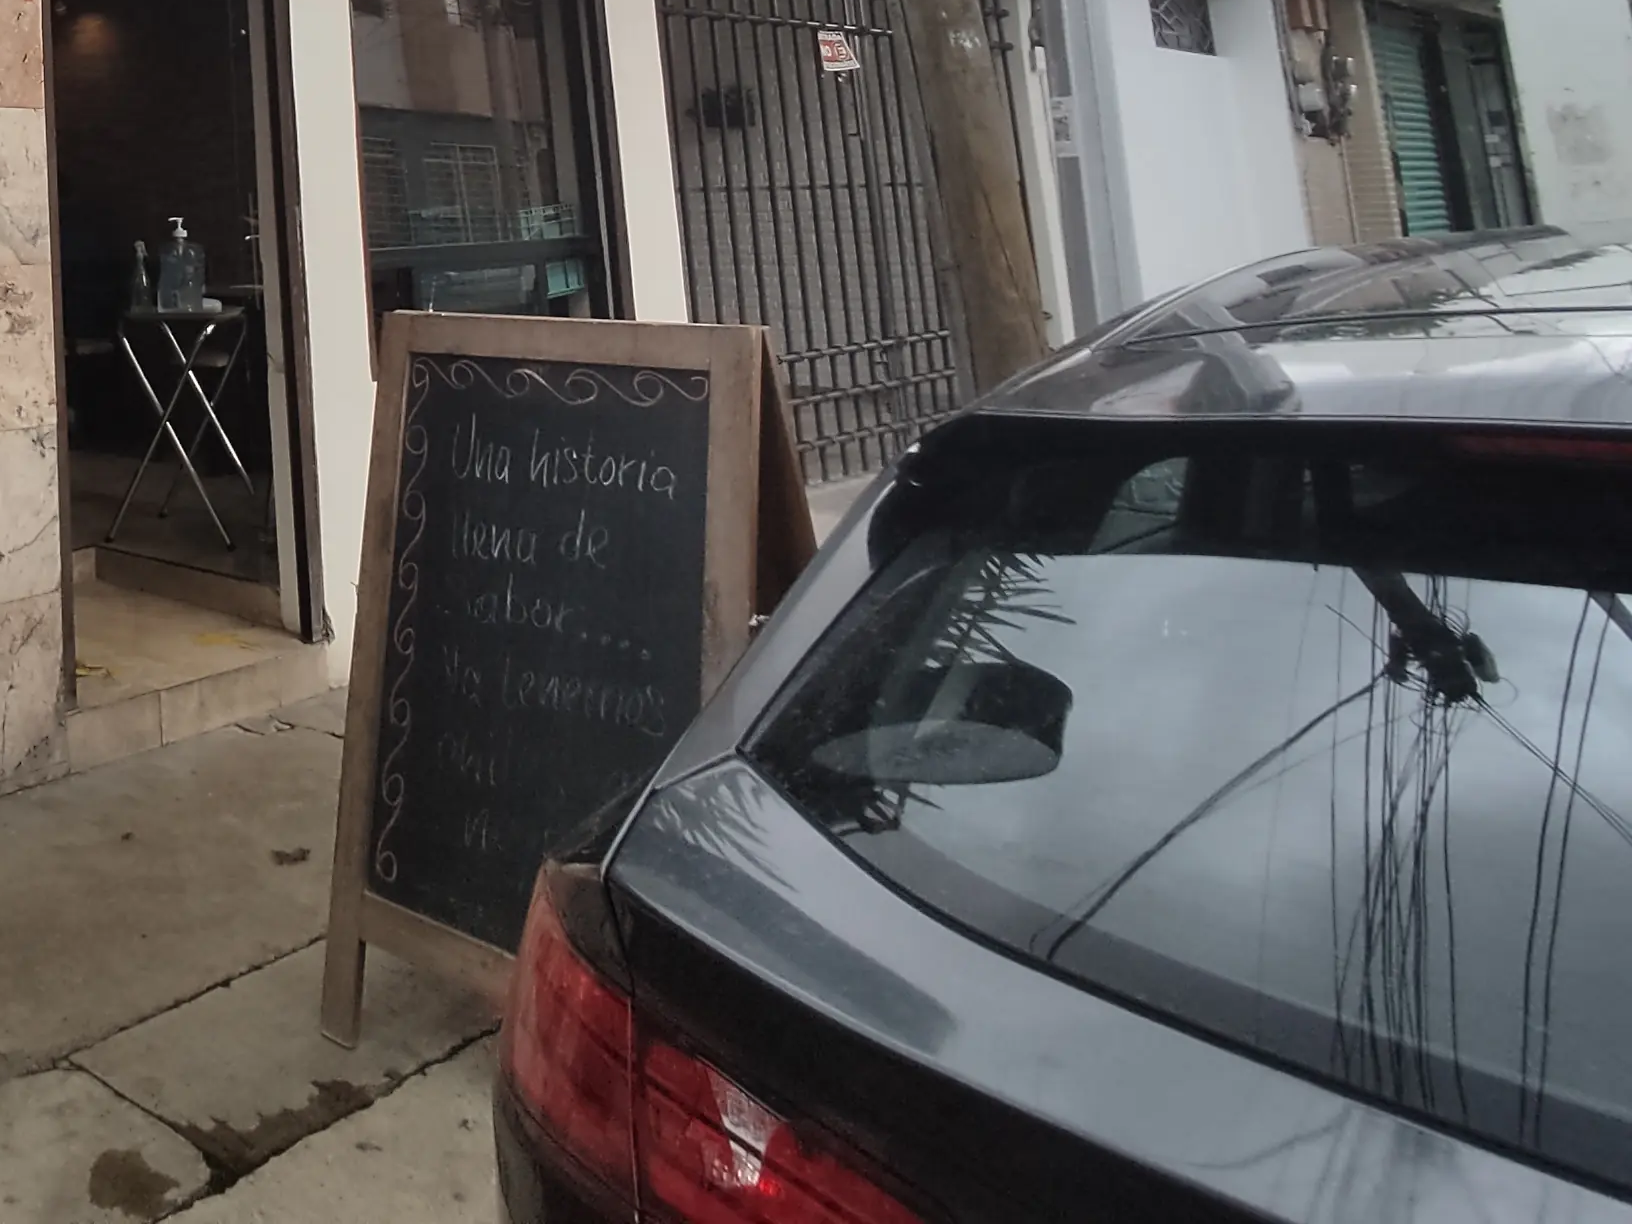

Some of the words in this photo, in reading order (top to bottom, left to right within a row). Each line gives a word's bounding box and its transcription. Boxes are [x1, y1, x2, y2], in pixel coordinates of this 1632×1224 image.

[452, 412, 510, 484] Una
[530, 427, 677, 501] historia
[451, 507, 537, 565] llena
[559, 508, 609, 570] de
